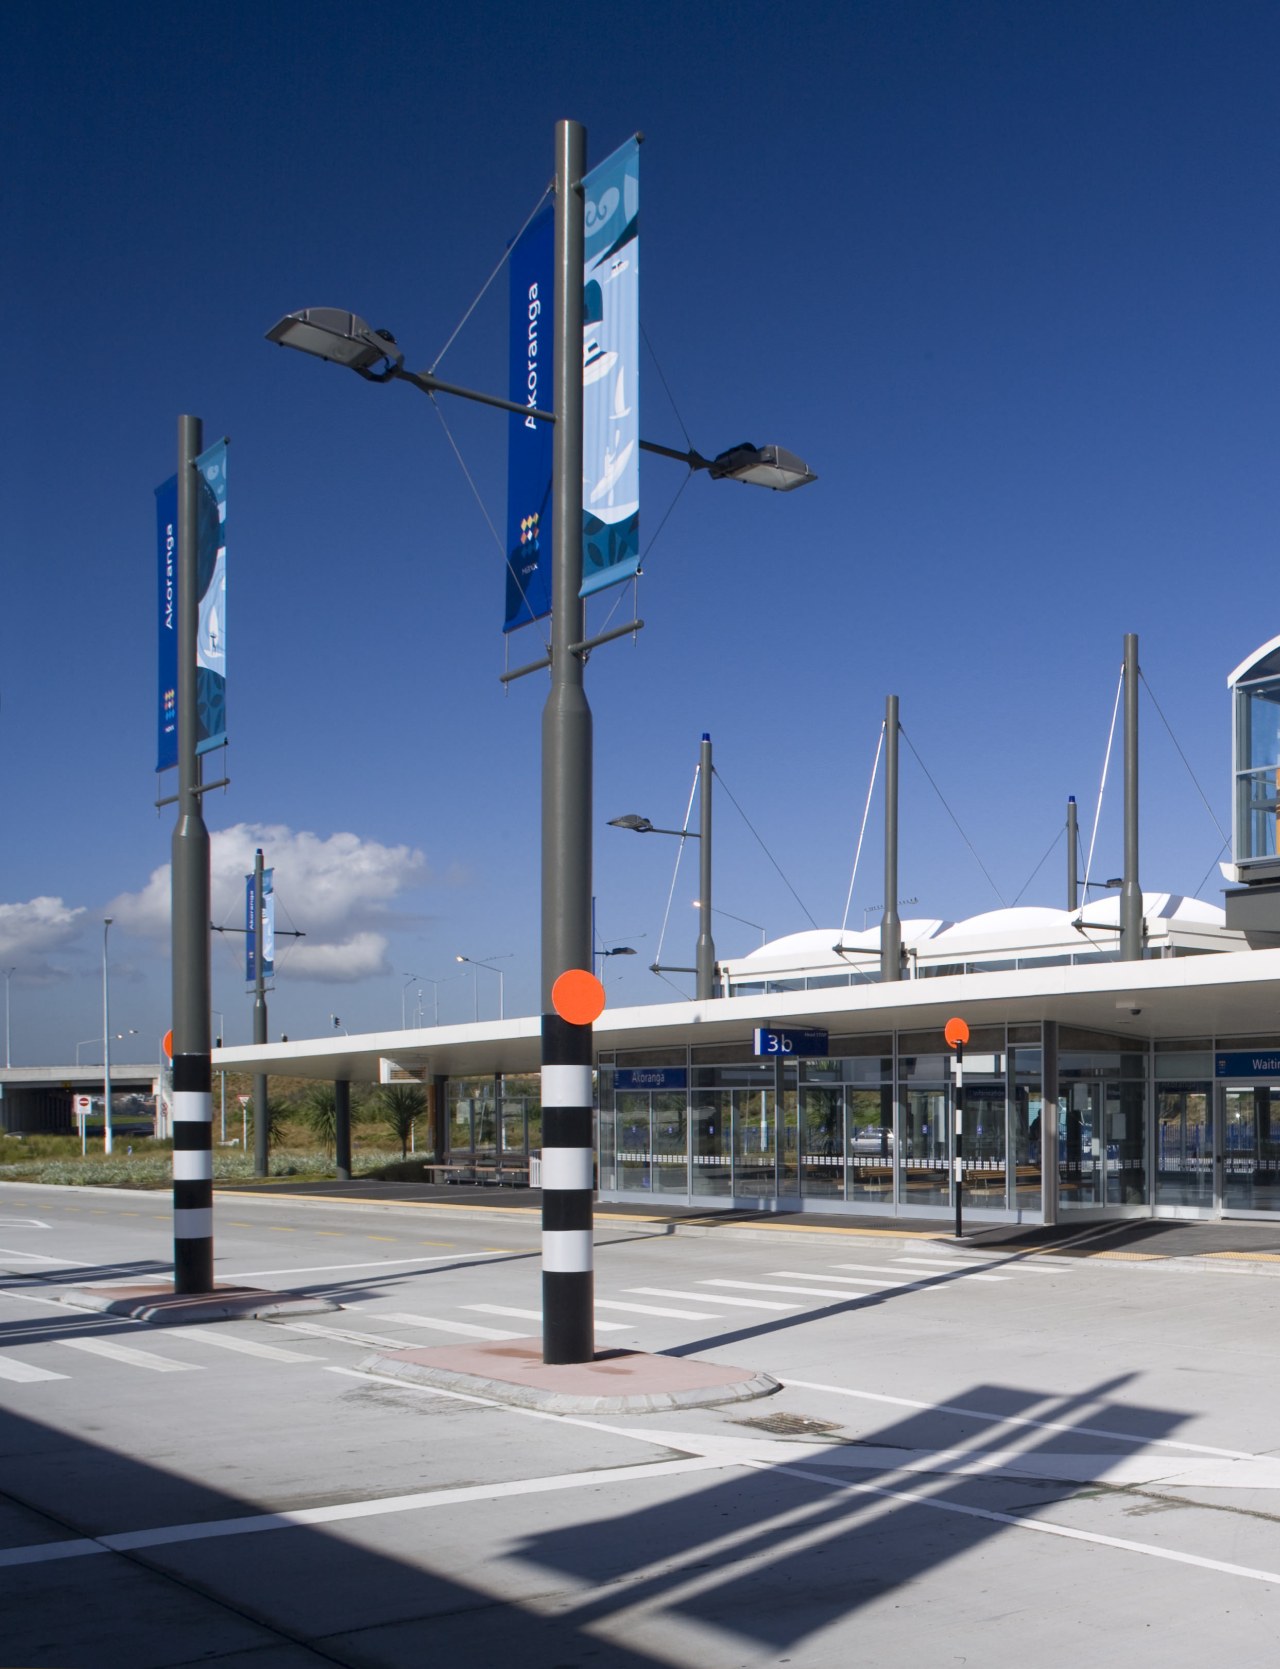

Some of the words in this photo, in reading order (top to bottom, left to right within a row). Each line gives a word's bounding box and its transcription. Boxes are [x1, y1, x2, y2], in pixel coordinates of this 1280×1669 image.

[524, 282, 541, 430] Akoranga
[164, 523, 175, 630] Akoranga
[632, 1071, 665, 1085] Akoranga
